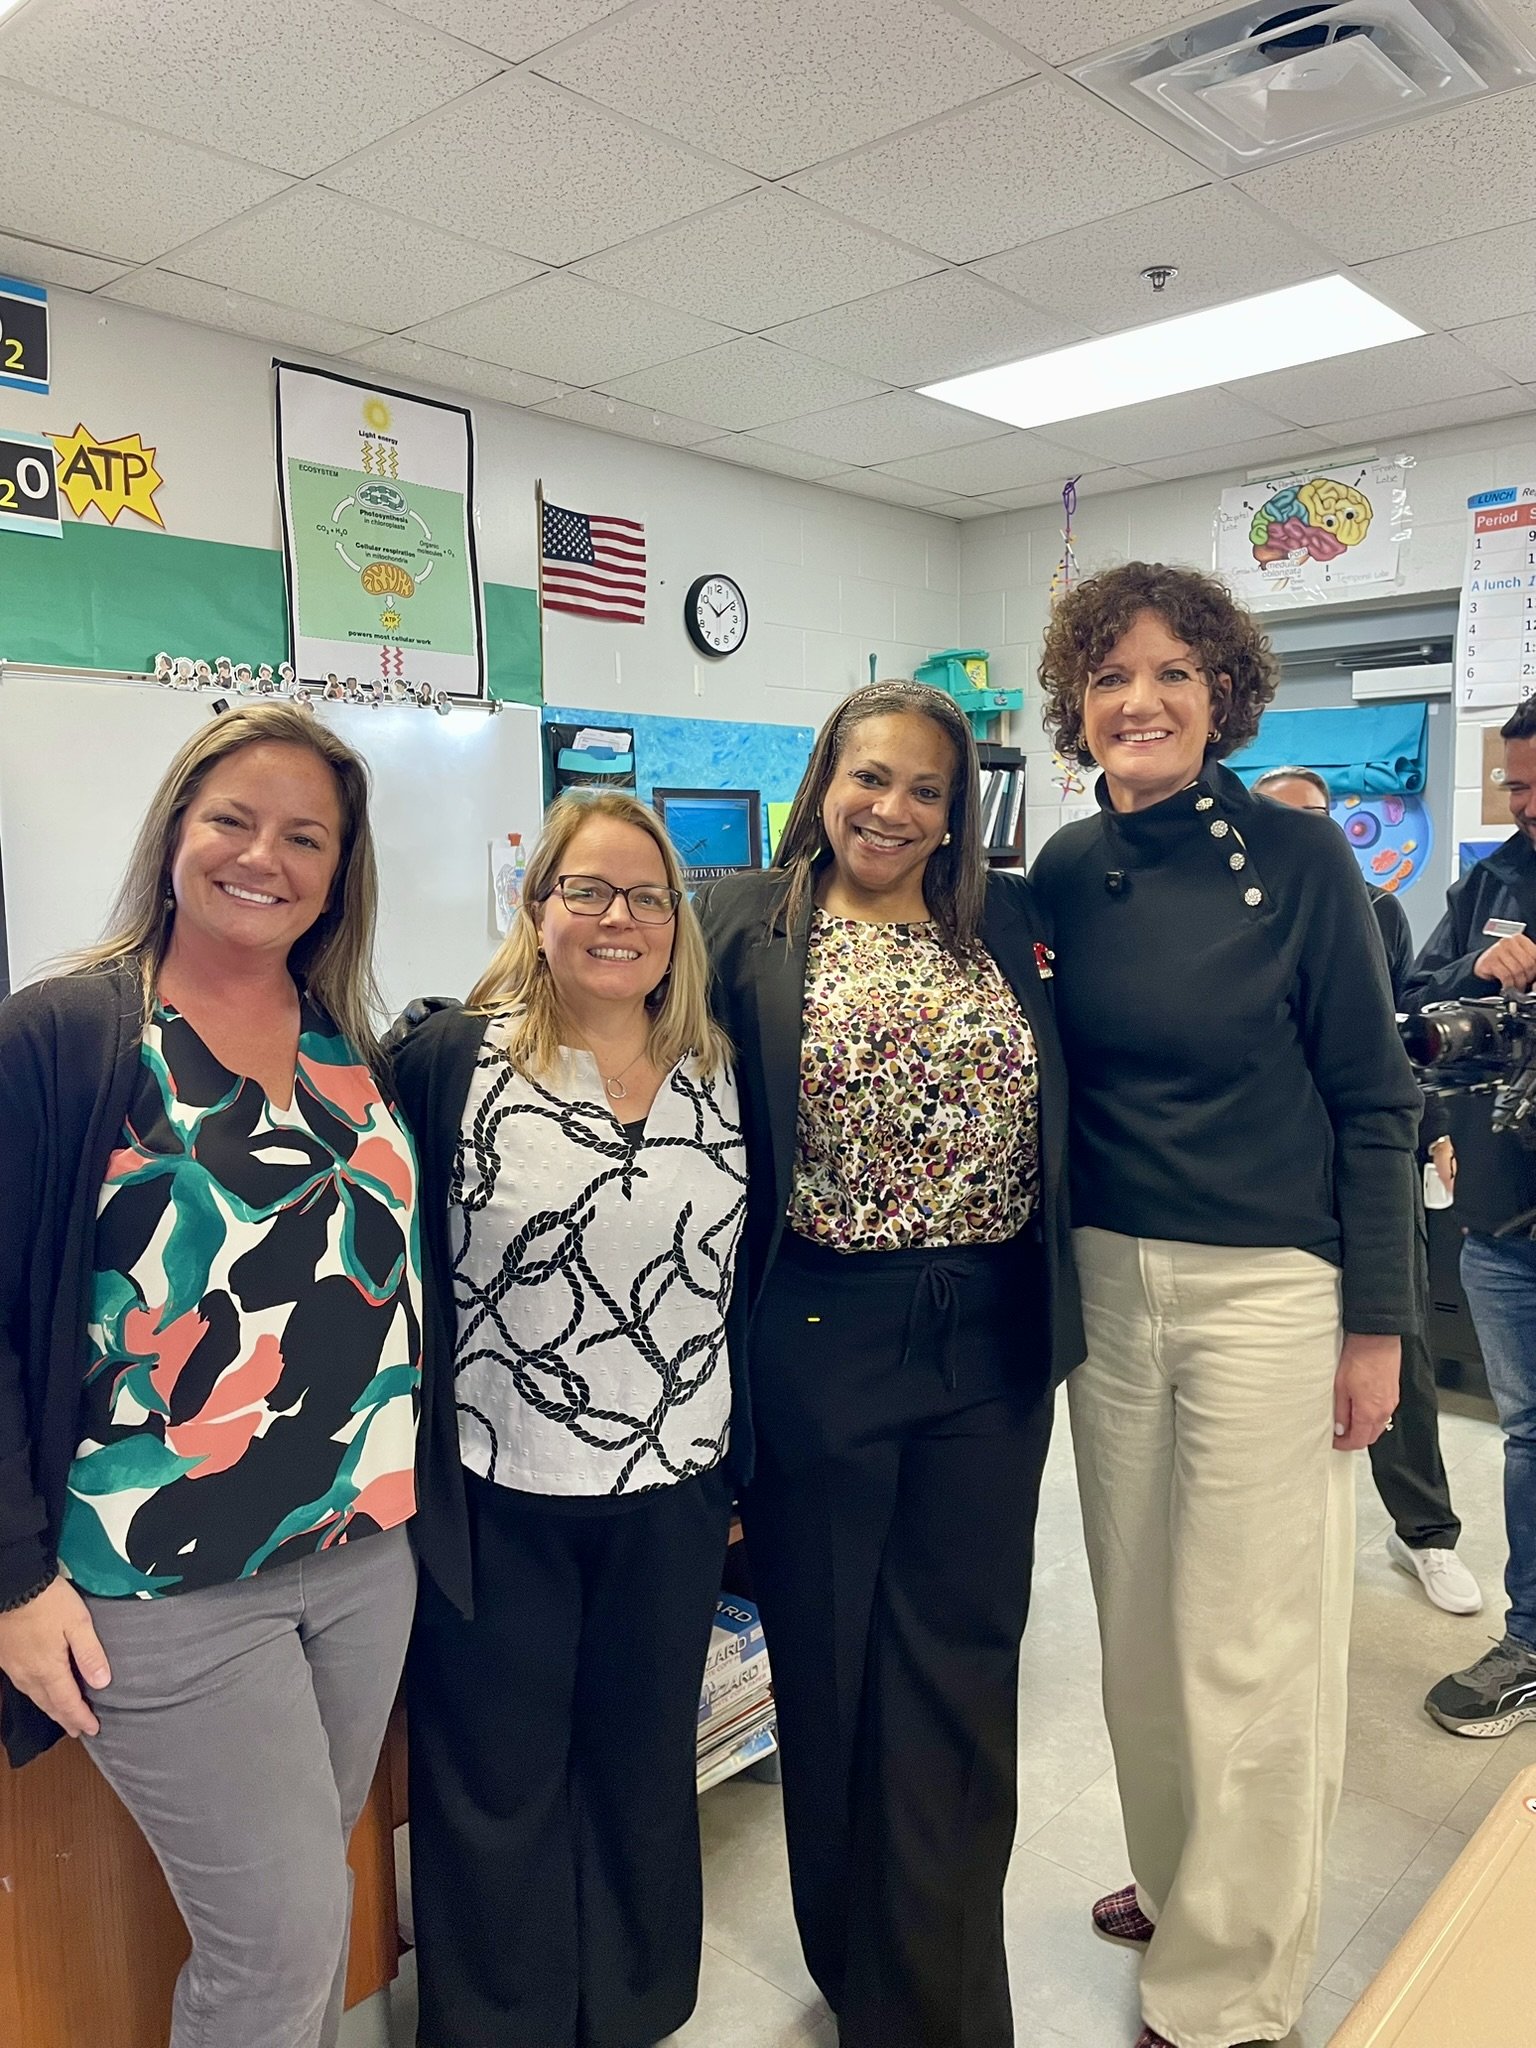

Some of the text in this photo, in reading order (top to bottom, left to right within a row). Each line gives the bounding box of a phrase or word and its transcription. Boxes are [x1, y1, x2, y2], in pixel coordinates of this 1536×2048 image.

[358, 430, 398, 445] Light energy
[62, 445, 147, 496] ATP
[299, 464, 339, 477] ECOSYSTEM
[1478, 490, 1514, 504] LUNCH
[360, 509, 408, 524] Photosynthesis
[1477, 510, 1518, 528] Period
[370, 519, 406, 530] chloroplasts
[420, 540, 439, 549] Organic
[1476, 538, 1481, 549] 1
[356, 542, 416, 558] Cellular respiration
[417, 548, 442, 557] molecules
[372, 552, 408, 563] mitochondria
[1474, 560, 1480, 570] 2
[714, 584, 722, 594] 12
[1472, 580, 1480, 592] A
[1484, 576, 1520, 590] lunch
[701, 594, 709, 604] 10
[730, 602, 736, 611] 2
[1470, 602, 1477, 613] 3
[732, 615, 738, 624] 3
[348, 630, 372, 638] powers
[1469, 624, 1476, 634] 4
[705, 630, 711, 639] 7
[723, 635, 730, 644] 5
[714, 638, 720, 646] 6
[1468, 646, 1475, 656] 5
[1467, 668, 1474, 678] 6
[1467, 689, 1474, 700] 7
[679, 868, 737, 878] MOTIVATION
